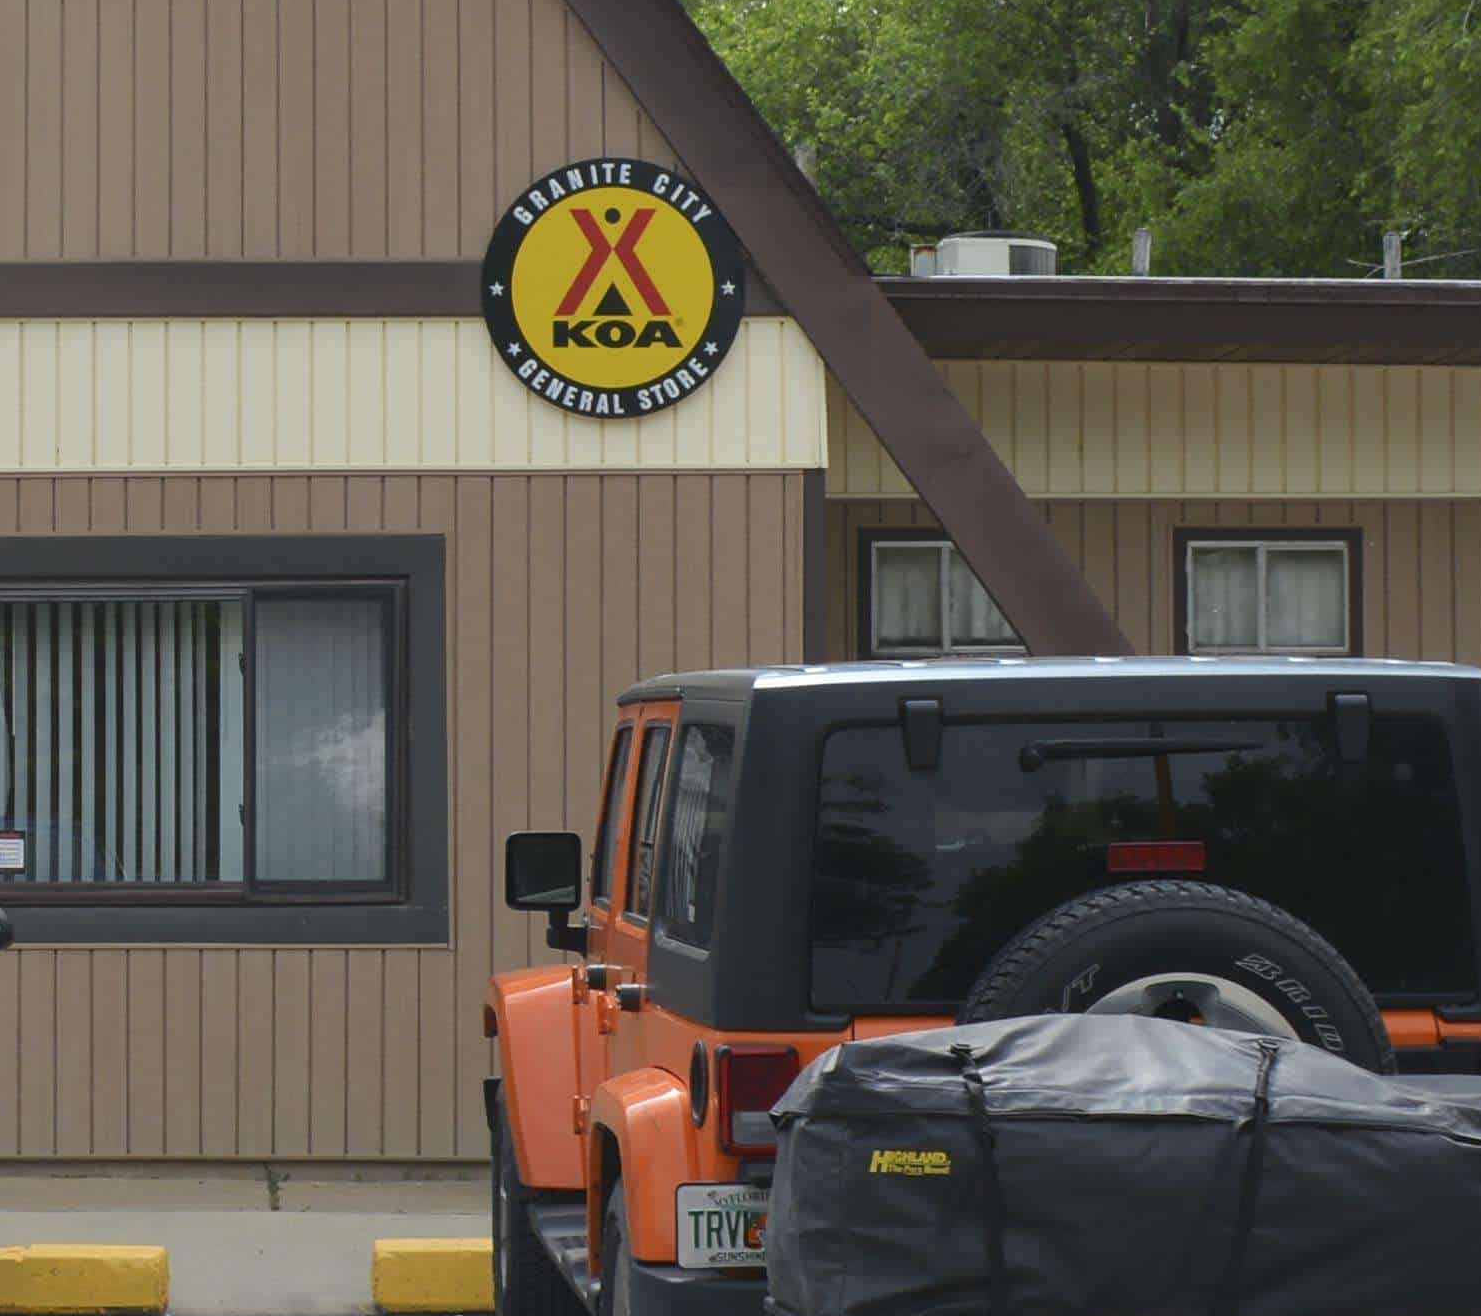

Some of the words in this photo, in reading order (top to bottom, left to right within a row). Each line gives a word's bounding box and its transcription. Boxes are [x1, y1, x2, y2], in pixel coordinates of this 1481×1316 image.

[513, 163, 632, 226] GRANITE
[652, 174, 712, 224] CITY
[552, 320, 684, 349] KOA
[517, 358, 625, 414] GENERAL
[637, 357, 709, 410] STORE
[869, 1150, 949, 1172] HIGHLAND
